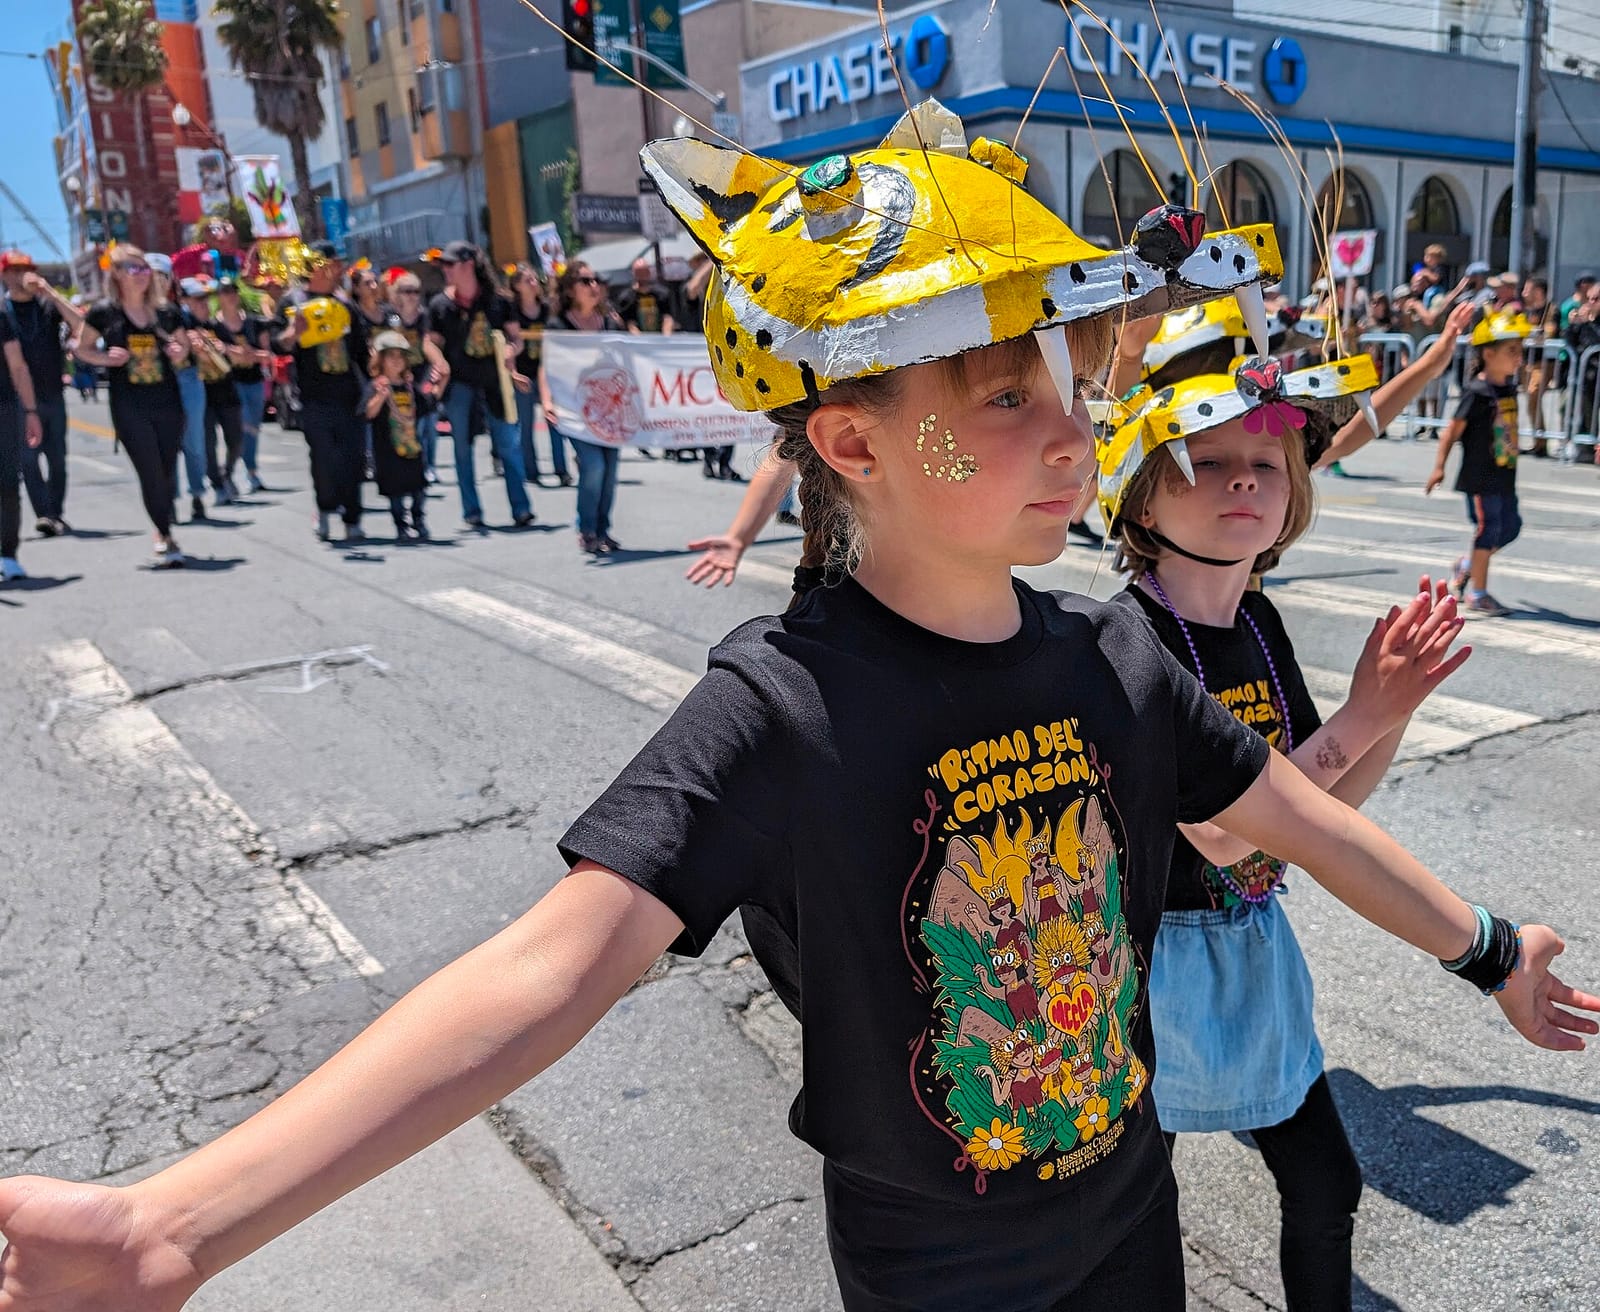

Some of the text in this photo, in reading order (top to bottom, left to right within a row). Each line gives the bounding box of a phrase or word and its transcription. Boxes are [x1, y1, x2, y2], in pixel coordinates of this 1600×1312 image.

[1068, 13, 1256, 93] CHASE
[768, 34, 901, 122] CHASE
[649, 366, 729, 408] MC
[1033, 718, 1084, 757] DEL
[953, 752, 1090, 823] CORAZÓN
[1056, 1142, 1092, 1168] MISSION
[1058, 1157, 1083, 1174] CENTER
[1059, 1156, 1099, 1180] CARNAVAL
